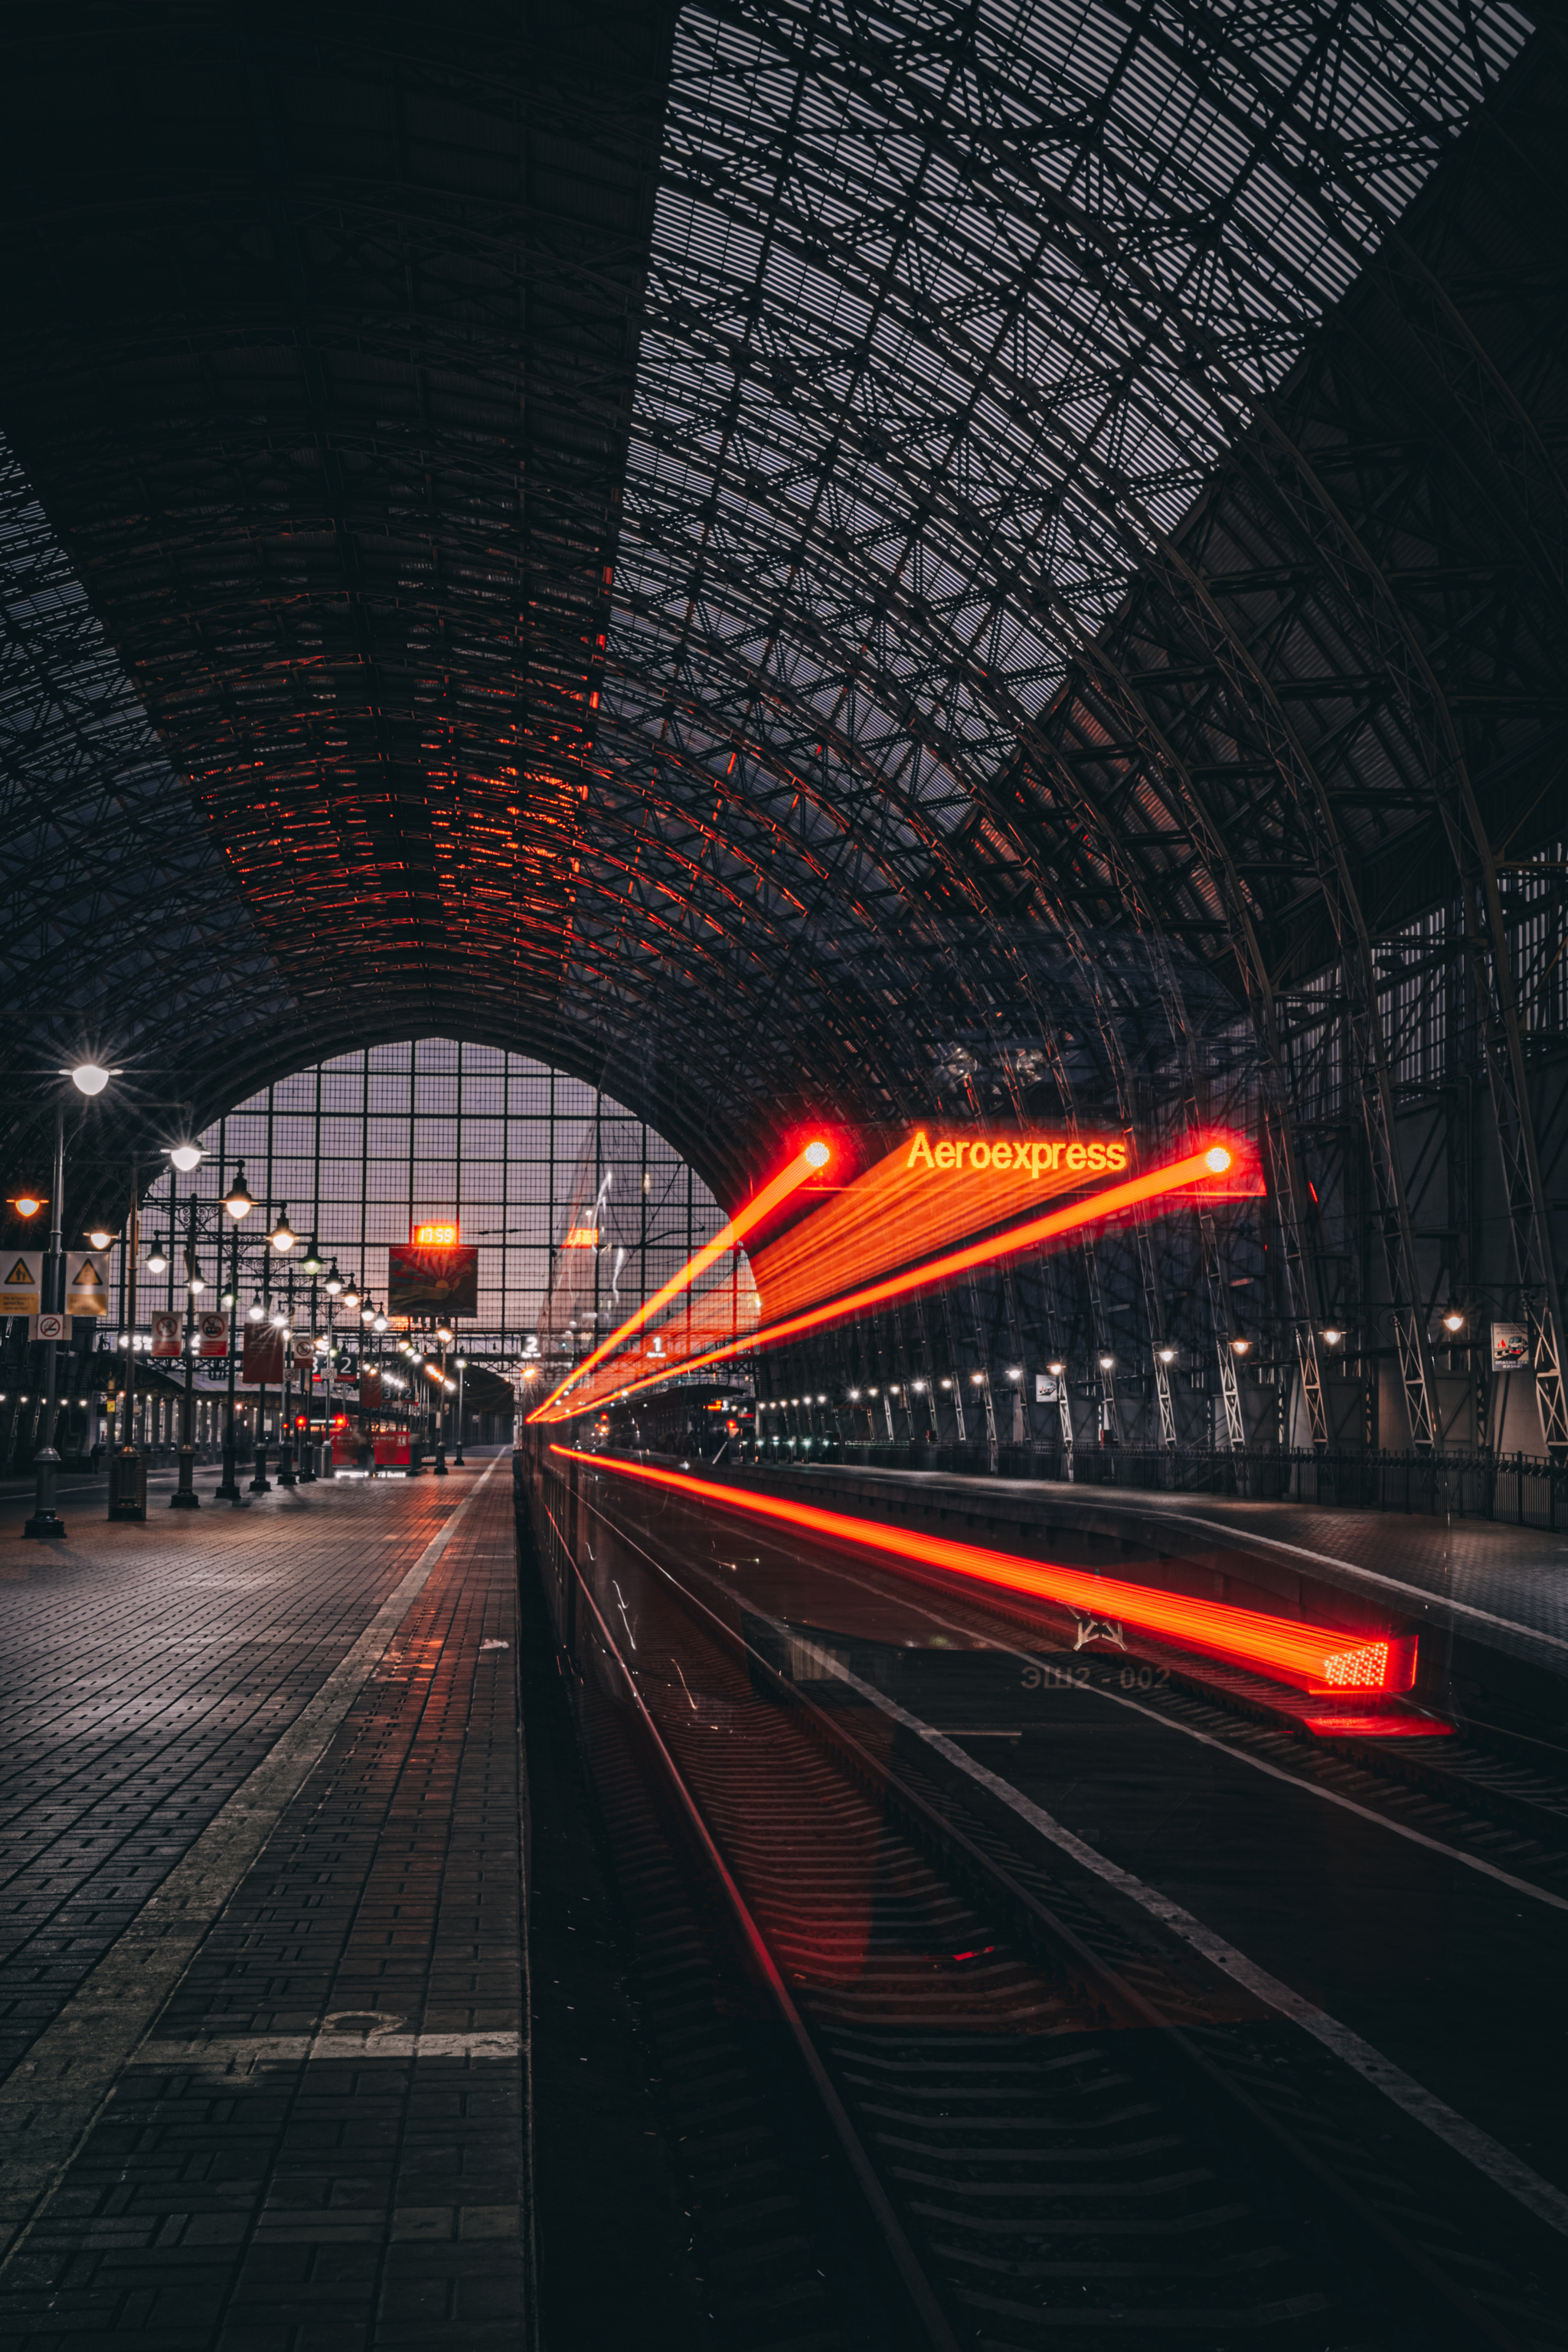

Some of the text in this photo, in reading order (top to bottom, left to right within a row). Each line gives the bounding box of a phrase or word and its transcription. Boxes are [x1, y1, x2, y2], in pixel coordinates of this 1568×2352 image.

[907, 1132, 1126, 1179] Aeroexpress
[526, 1336, 537, 1353] 2
[652, 1336, 662, 1353] 1
[340, 1357, 351, 1374] 2
[384, 1388, 391, 1399] 3
[404, 1388, 412, 1399] 2
[1021, 1666, 1090, 1689] ЭШ2
[1120, 1666, 1171, 1689] 002
